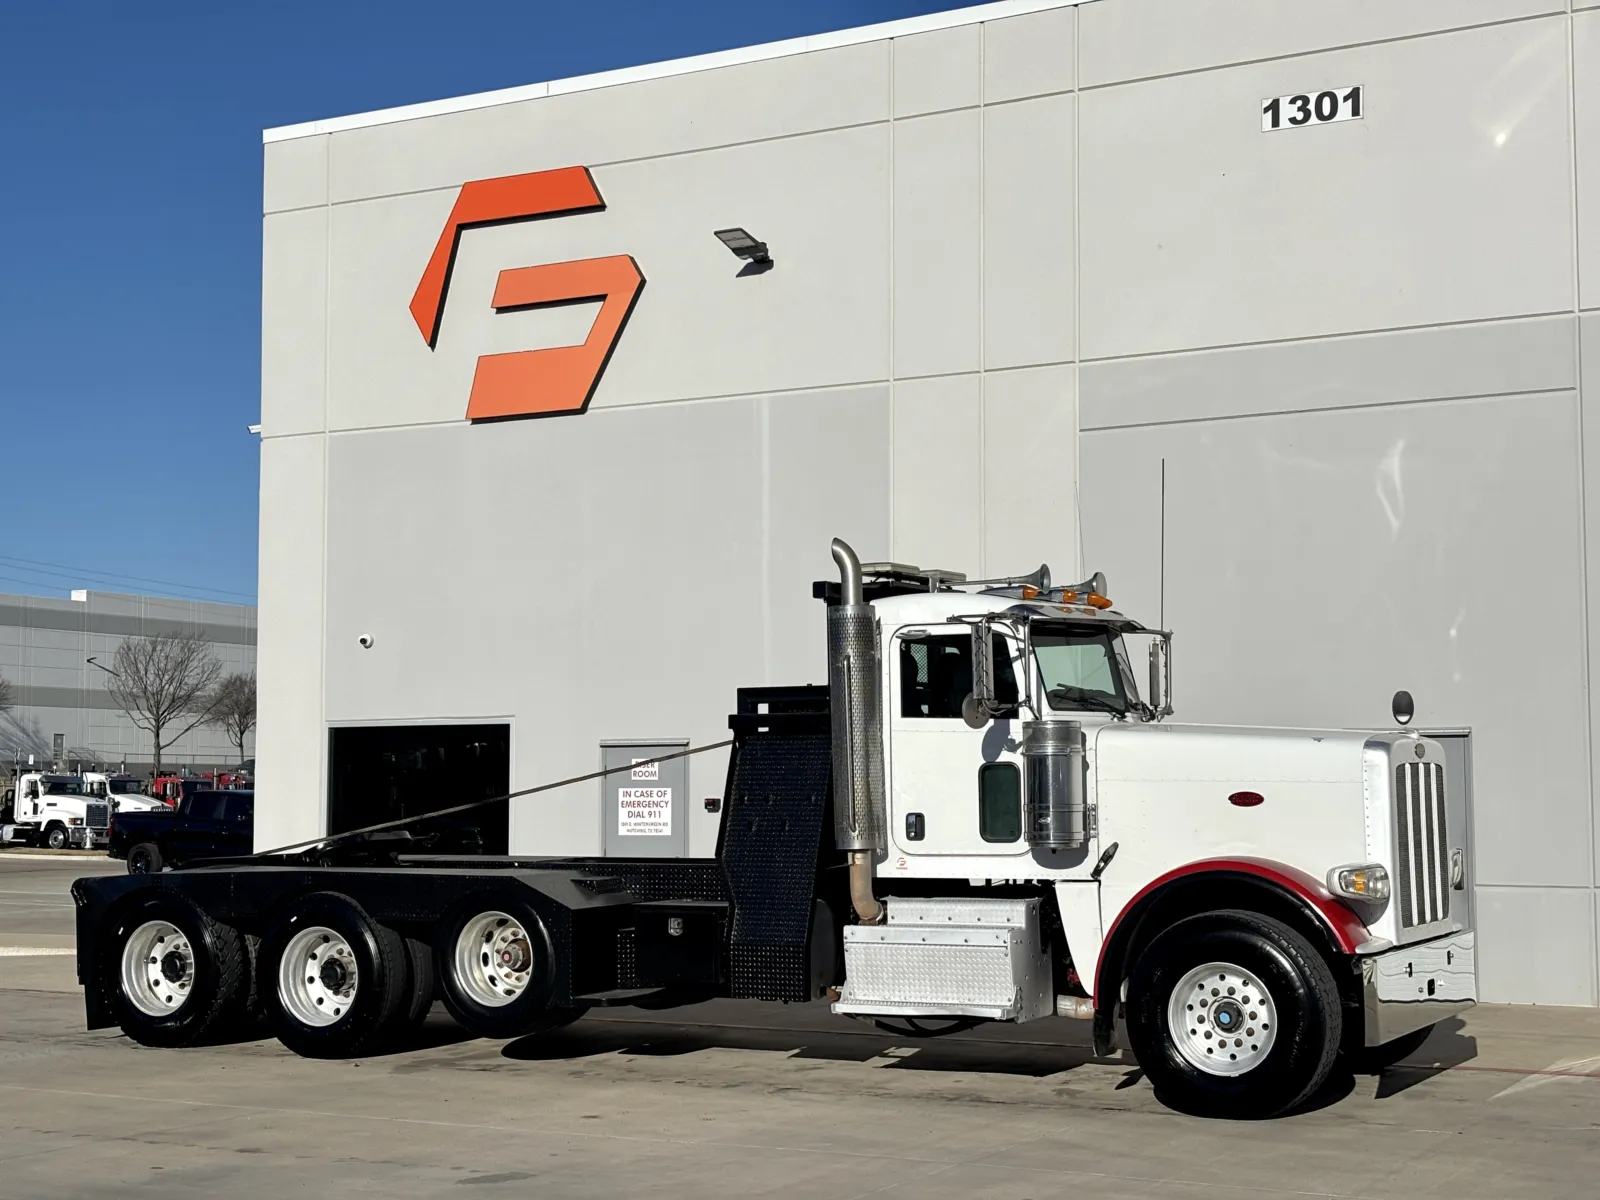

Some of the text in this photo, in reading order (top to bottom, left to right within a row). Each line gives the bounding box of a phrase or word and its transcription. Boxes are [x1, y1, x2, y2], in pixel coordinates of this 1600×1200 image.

[1263, 86, 1361, 128] 1301
[633, 770, 657, 778] ROOM
[622, 790, 668, 798] IN CASE OF
[621, 800, 669, 808] EMERGENCY
